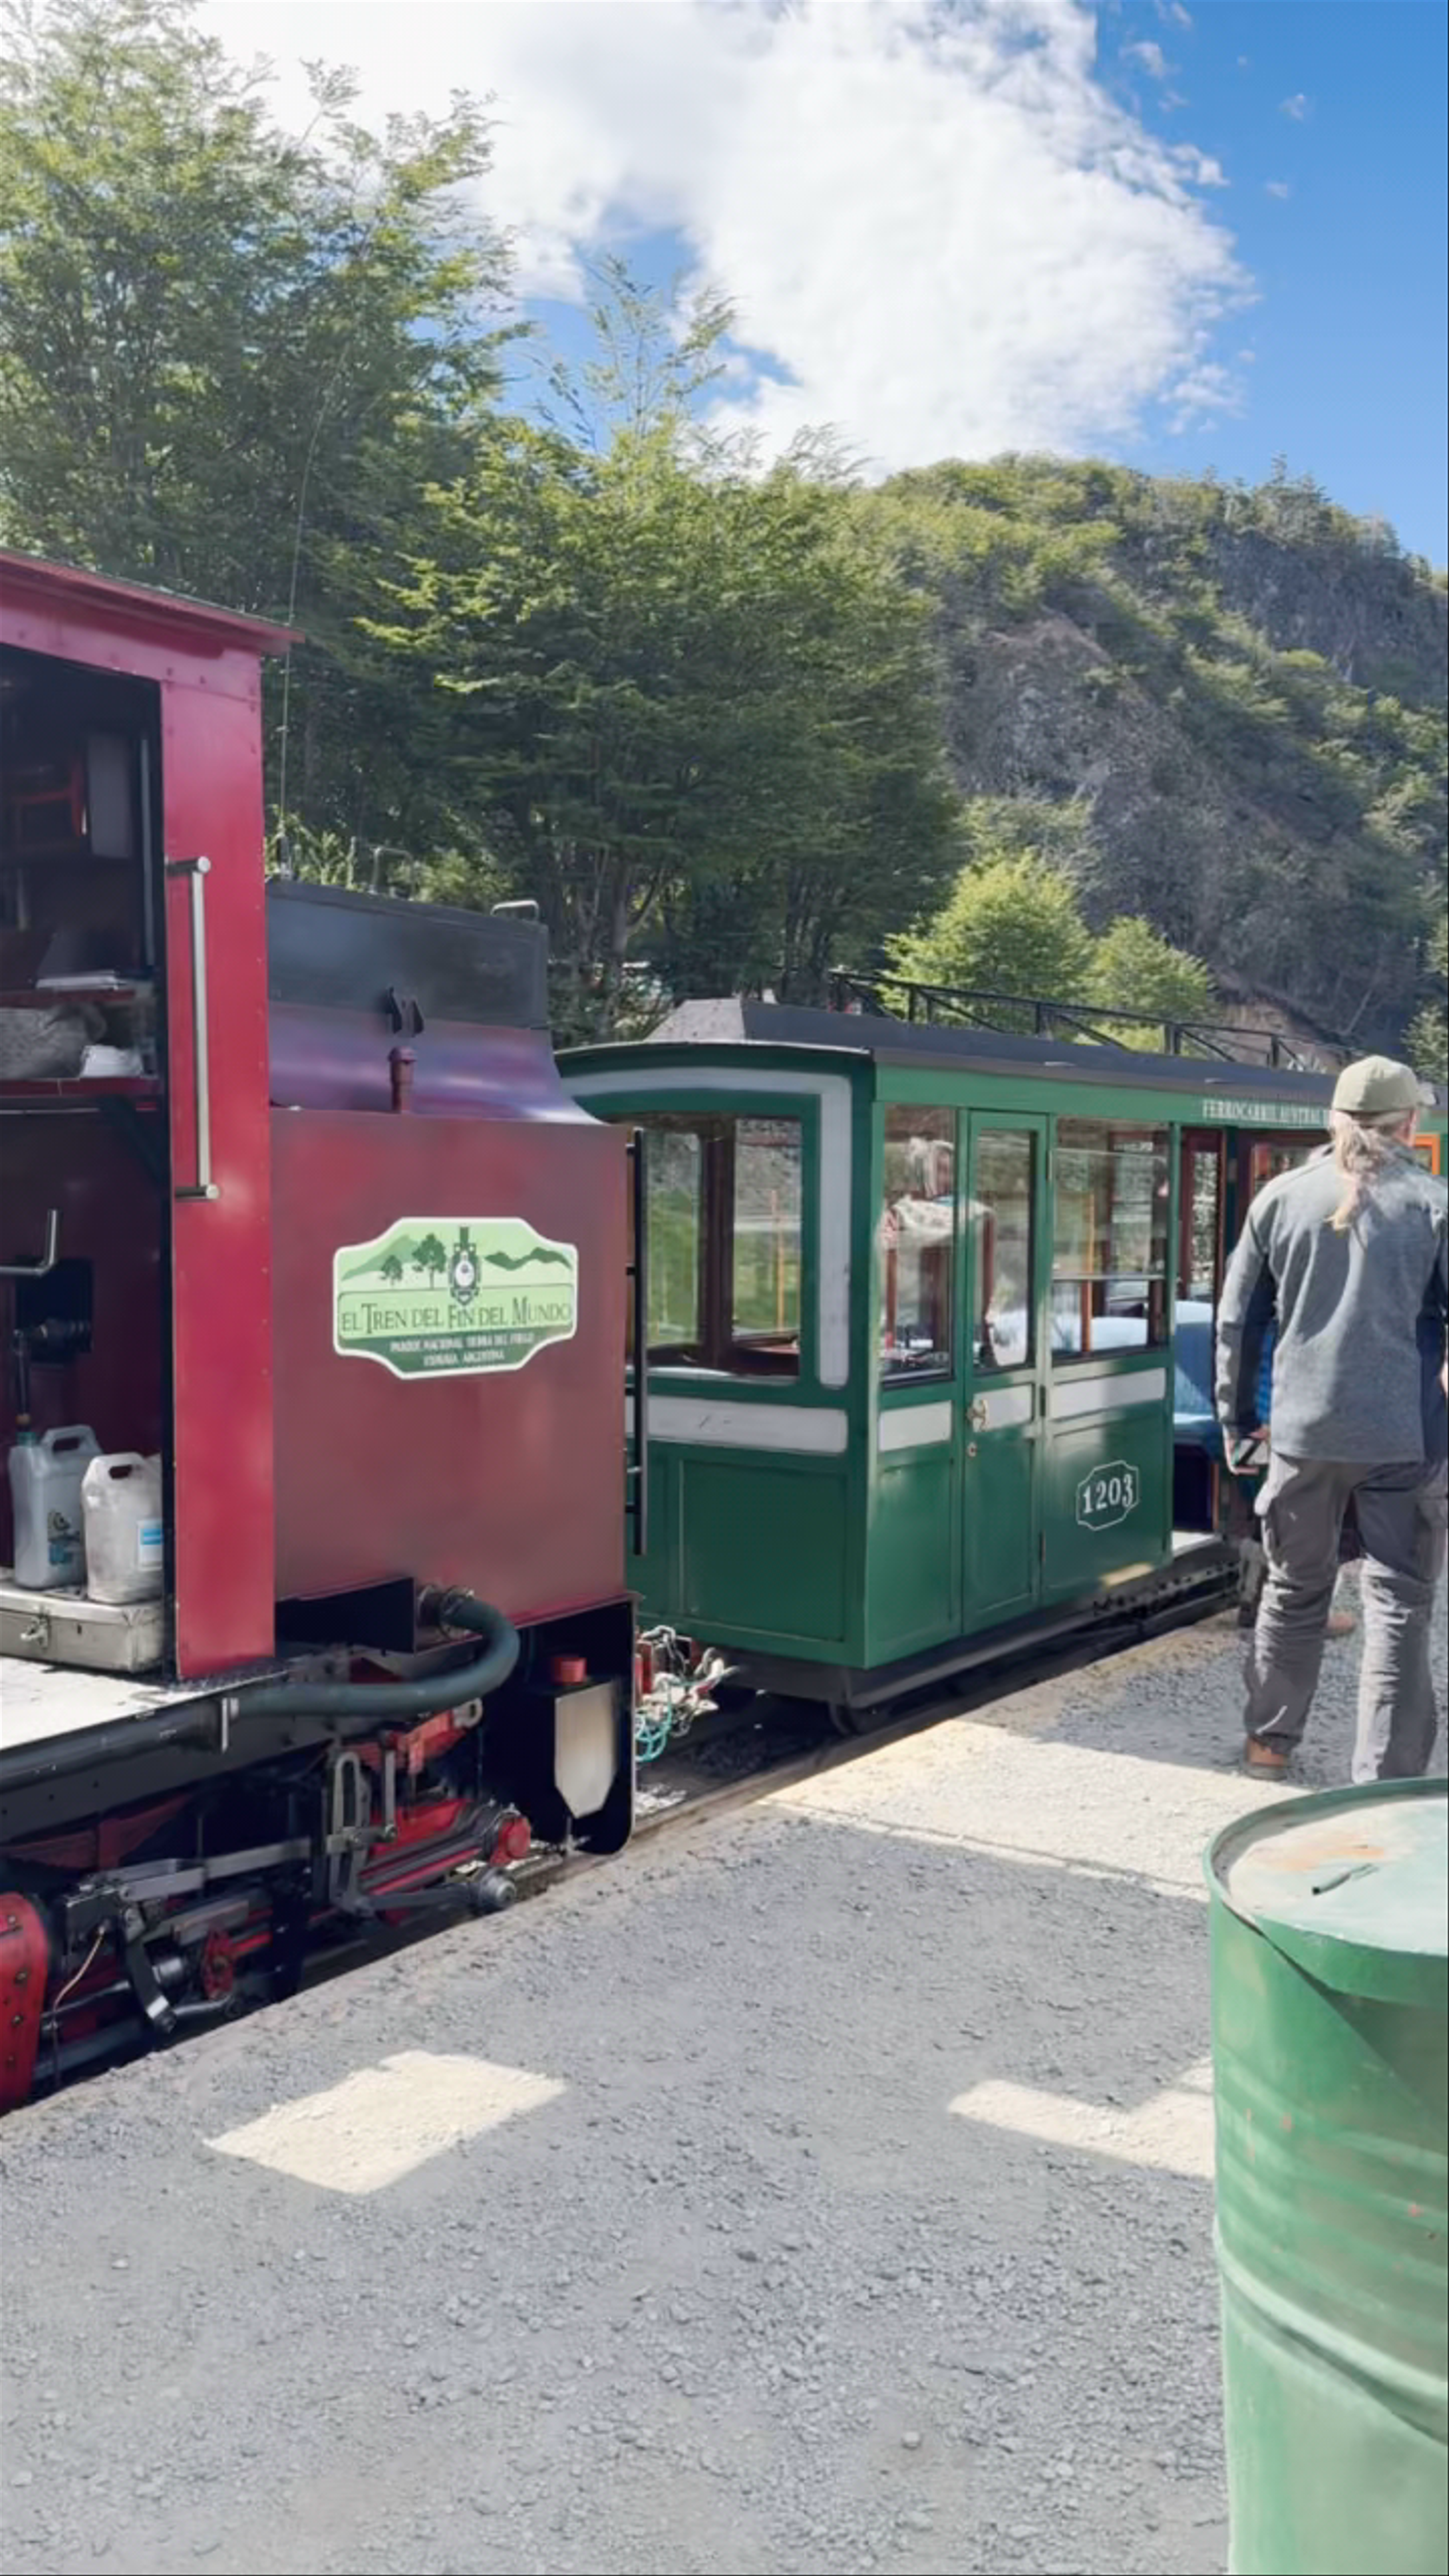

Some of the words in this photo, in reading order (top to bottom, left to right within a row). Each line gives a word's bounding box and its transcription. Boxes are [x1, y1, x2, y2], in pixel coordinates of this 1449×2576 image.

[341, 1312, 363, 1331] EL
[361, 1303, 407, 1334] TREN
[411, 1308, 444, 1327] DEL
[448, 1304, 474, 1329] FIN
[478, 1307, 510, 1326] DEL
[512, 1296, 571, 1325] MUNDO
[1083, 1474, 1132, 1513] 1203
